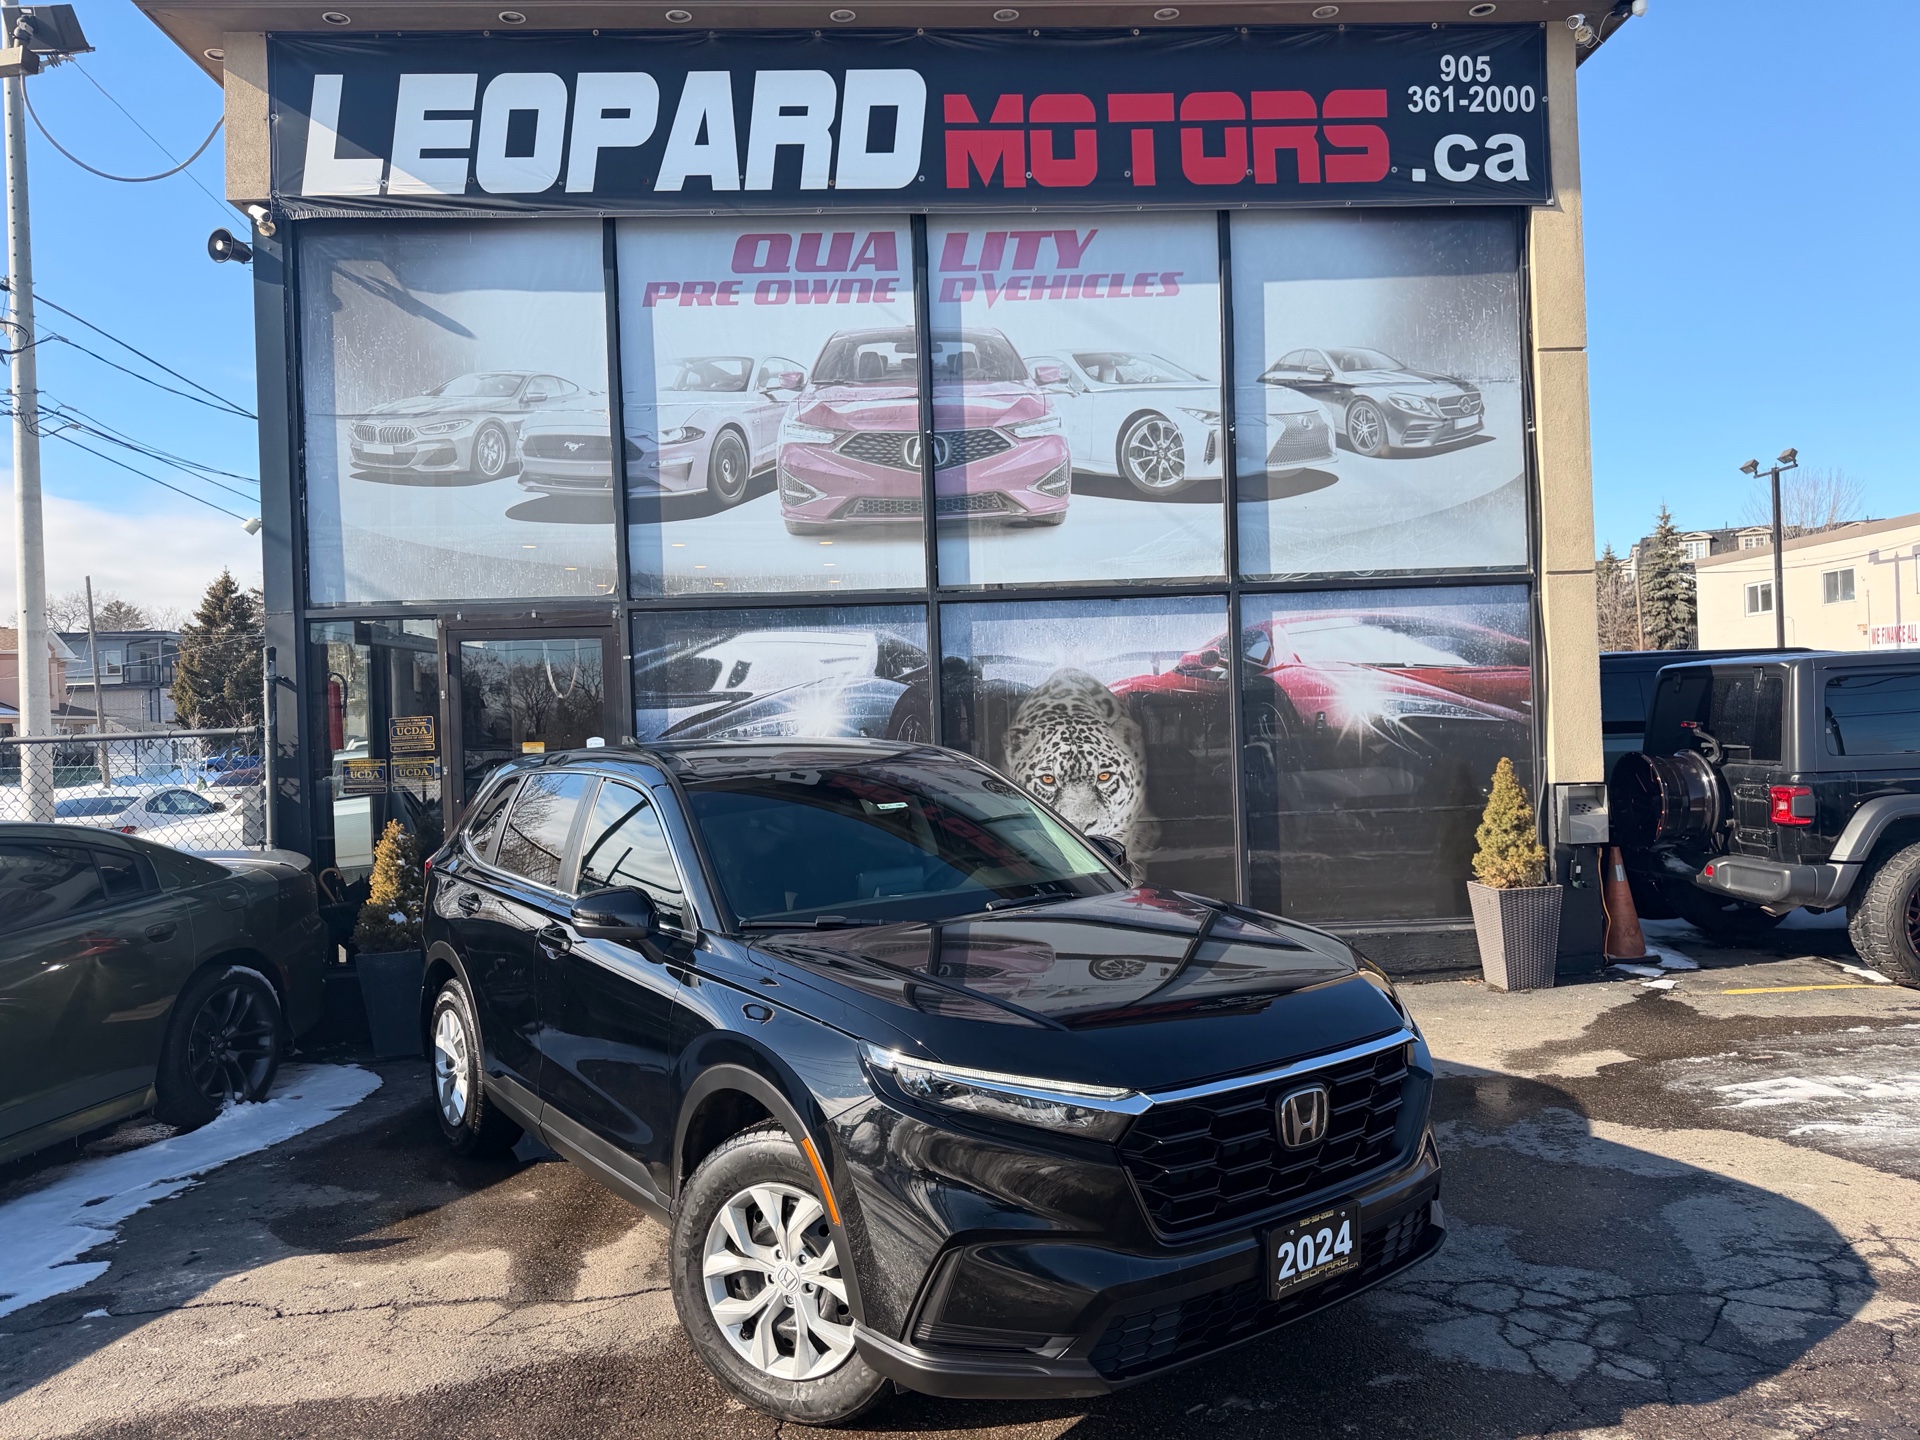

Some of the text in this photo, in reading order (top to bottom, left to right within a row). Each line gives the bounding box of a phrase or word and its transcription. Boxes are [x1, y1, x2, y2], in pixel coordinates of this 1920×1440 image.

[1440, 54, 1491, 82] 905
[1407, 85, 1535, 113] 361-2000
[302, 69, 1530, 196] LEOPARD MOTORS .ca
[642, 281, 743, 307] PRE
[1871, 624, 1918, 645] WE FINANCE ALL
[396, 726, 428, 736] UCDA
[350, 769, 380, 779] UCDA
[399, 768, 429, 777] UCDA
[1277, 1219, 1353, 1281] 2024
[1293, 1256, 1349, 1284] LEOPARD
[707, 1350, 769, 1406] WEATHERGRIP
